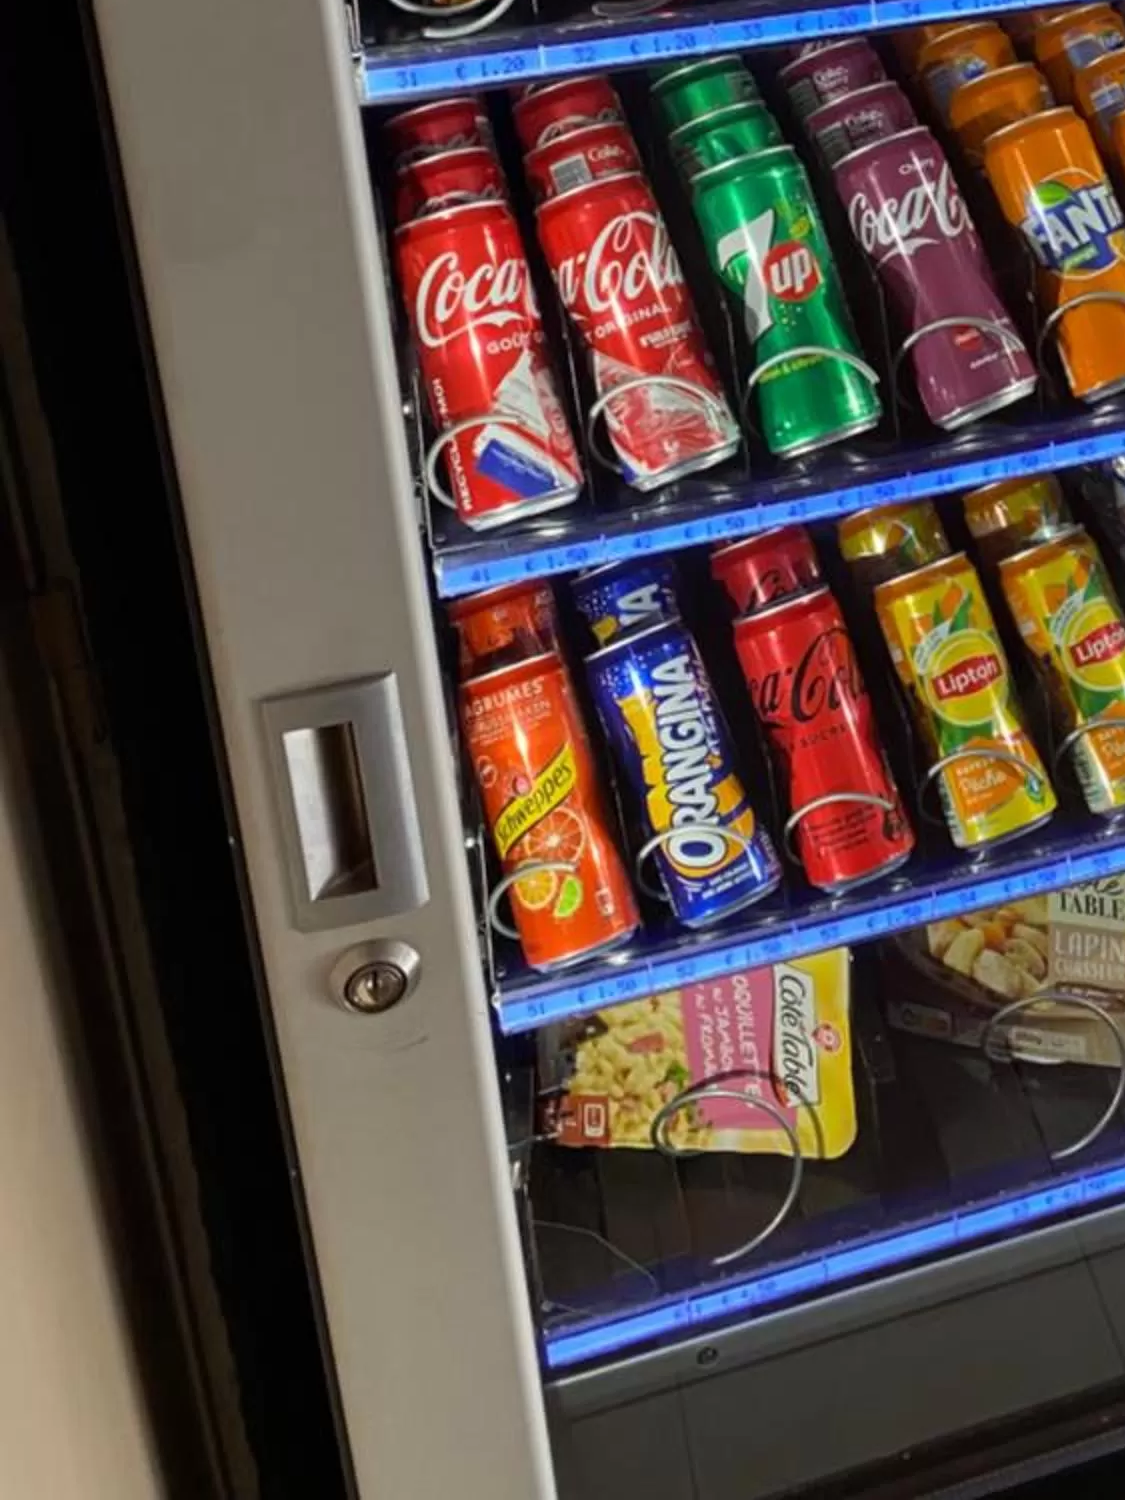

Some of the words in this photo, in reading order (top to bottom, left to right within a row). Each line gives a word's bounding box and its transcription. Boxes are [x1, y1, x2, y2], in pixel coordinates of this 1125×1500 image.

[479, 54, 526, 77] 1.20
[652, 31, 696, 53] 1.20
[1020, 180, 1124, 270] FANT
[716, 208, 776, 346] 7
[936, 660, 999, 696] Lipton
[497, 759, 574, 843] Schweppes
[650, 652, 728, 870] ORANGINA
